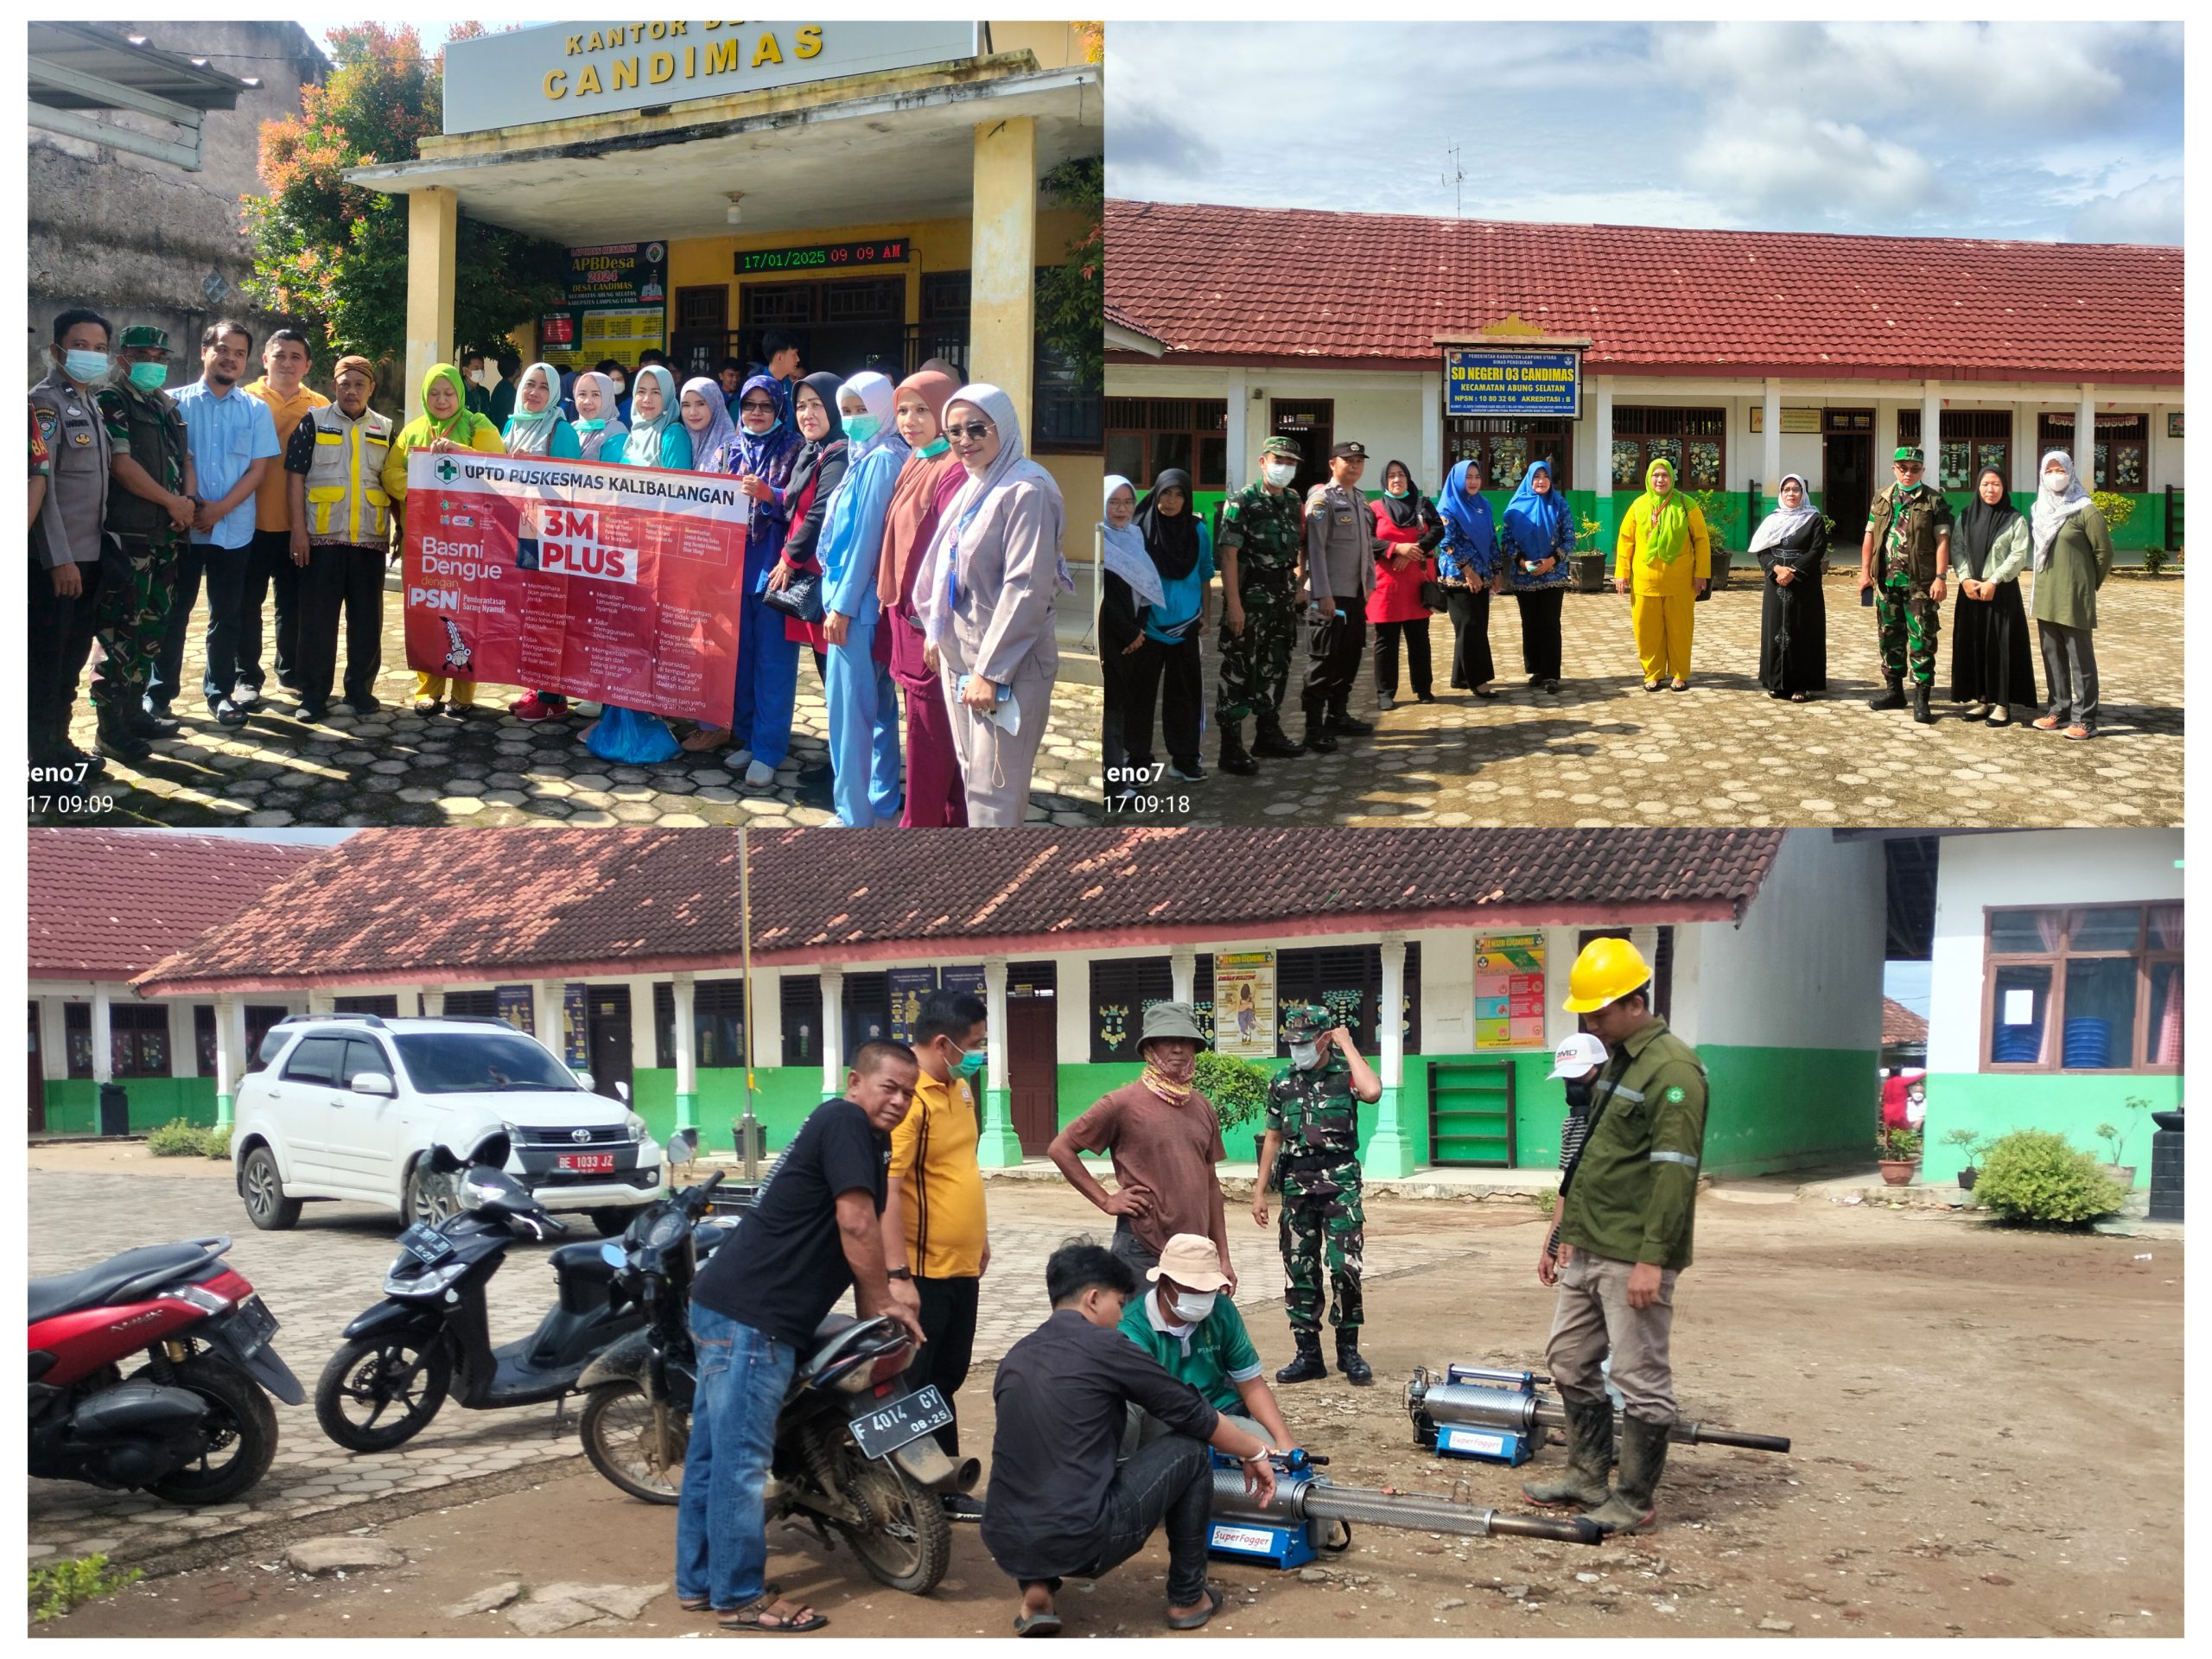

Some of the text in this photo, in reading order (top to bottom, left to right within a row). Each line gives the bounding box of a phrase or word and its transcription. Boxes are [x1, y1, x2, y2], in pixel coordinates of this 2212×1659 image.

[566, 20, 687, 55] KANTOR
[542, 24, 823, 100] CANDIMAS
[745, 245, 902, 269] 17/01/2025 09 09 AM
[572, 257, 635, 271] APBDesa
[588, 270, 619, 283] 2024
[594, 282, 633, 291] CANDIMAS
[1452, 366, 1574, 382] SD NEGERI 03 CANDIMAS
[465, 465, 735, 506] UPTD PUSKESMAS KALIBALANGAN
[544, 510, 594, 541] 3M
[422, 536, 485, 559] Basmi
[542, 542, 626, 578] PLUS
[422, 556, 502, 582] Dengue
[422, 575, 459, 589] dengan
[527, 582, 561, 592] Memelihara
[463, 594, 506, 606] Pemberantasan
[596, 592, 625, 601] Menanam
[463, 602, 506, 613] Sarang Nyamuk
[595, 606, 618, 614] nyamuk
[596, 598, 647, 613] tanaman pengusir
[662, 603, 712, 619] Menjaga ruangan
[525, 608, 551, 617] Memakai
[674, 613, 690, 621] tidak
[672, 620, 696, 629] lembab
[593, 632, 618, 642] kelambu
[594, 626, 635, 638] menggunakan
[660, 631, 681, 641] Pasang
[523, 643, 562, 655] Menggantung
[659, 639, 674, 647] pada
[522, 650, 543, 658] pakaian
[591, 647, 629, 658] Memperbaiki
[591, 654, 612, 663] saluran
[590, 661, 609, 670] talang
[541, 672, 561, 682] royong
[605, 670, 622, 678] lancar
[664, 667, 686, 677] tempat
[520, 675, 550, 687] lingkungan
[567, 685, 588, 694] minggu
[656, 680, 677, 690] daerah
[611, 693, 629, 702] dapat
[629, 696, 668, 710] menampung
[613, 685, 655, 699] Mengeringkan
[655, 693, 677, 704] tempat
[690, 700, 706, 709] yang
[559, 1155, 613, 1168] BE 1033 JZ
[854, 1423, 866, 1440] F
[872, 1405, 907, 1431] 4014
